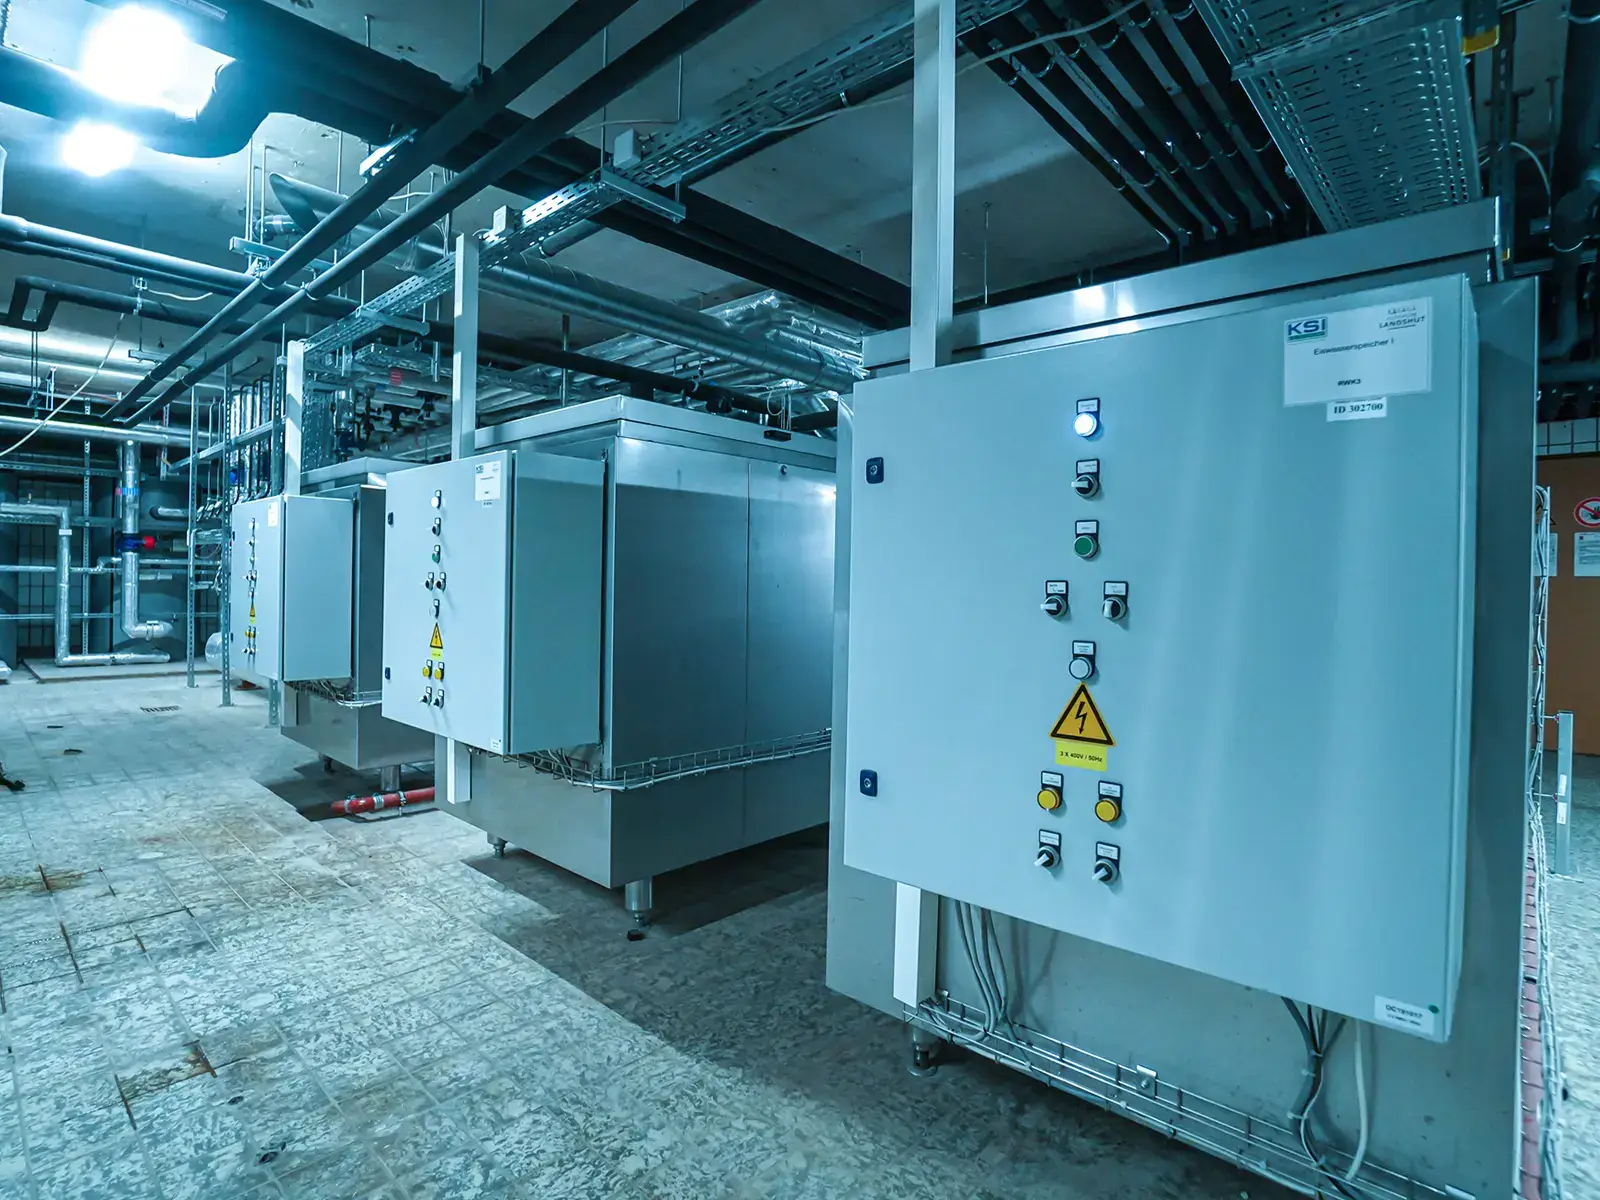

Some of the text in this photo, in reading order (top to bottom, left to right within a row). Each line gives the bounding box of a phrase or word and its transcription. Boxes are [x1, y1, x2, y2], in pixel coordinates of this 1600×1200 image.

[1287, 318, 1326, 336] KSI
[1333, 402, 1384, 414] ID 302700
